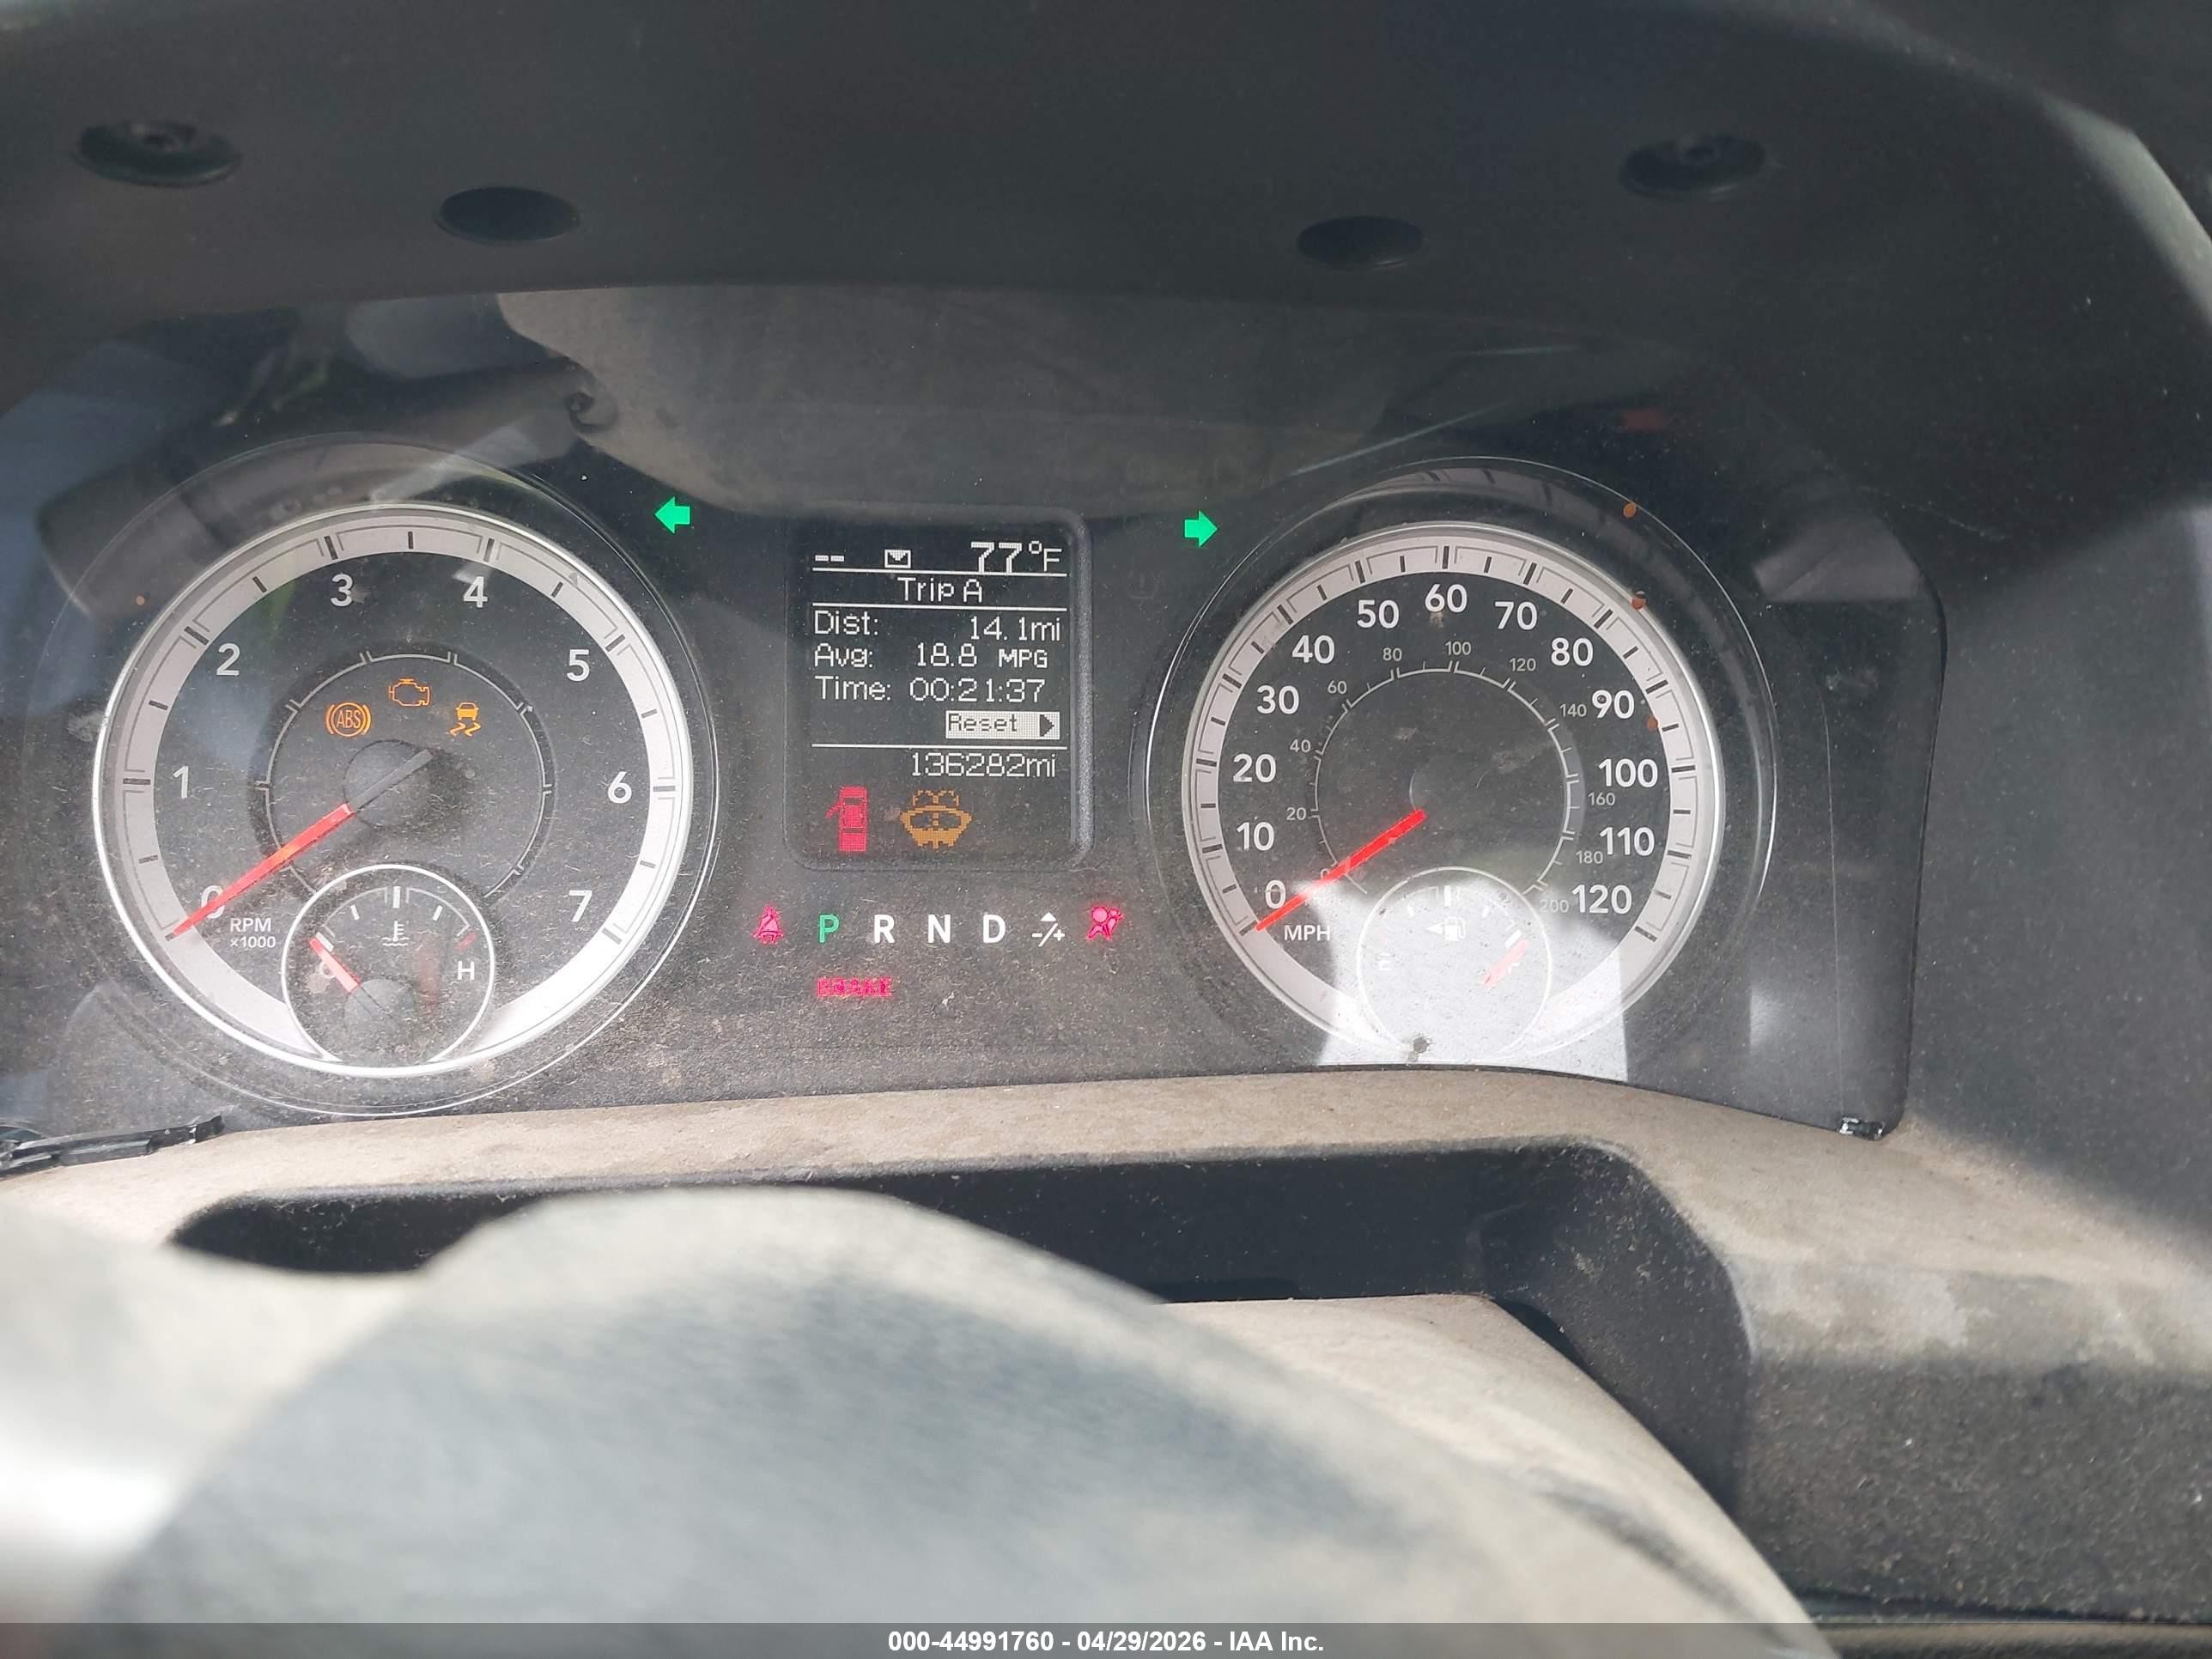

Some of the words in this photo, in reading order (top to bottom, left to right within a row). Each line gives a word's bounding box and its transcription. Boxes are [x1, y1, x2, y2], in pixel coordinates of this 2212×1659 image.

[330, 573, 354, 607] 3
[462, 575, 489, 608] 4
[896, 577, 956, 603] Trip
[963, 579, 983, 604] A
[1425, 583, 1468, 613] 60
[814, 610, 879, 635] Dist:
[1356, 599, 1400, 629] 50
[1494, 601, 1539, 630] 70
[216, 642, 241, 676] 2
[814, 642, 874, 668] Avg:
[916, 642, 978, 668] 18.8
[998, 648, 1048, 669] MPG
[1291, 635, 1335, 664] 40
[1382, 647, 1402, 662] 80
[1444, 641, 1472, 656] 100
[1550, 637, 1594, 666] 80
[565, 647, 591, 682] 5
[1509, 657, 1537, 672] 120
[814, 675, 892, 702] Time:
[908, 677, 1046, 702] 00:21:37
[1256, 685, 1299, 714] 30
[1327, 679, 1347, 695] 60
[337, 708, 361, 729] ABS
[1559, 703, 1587, 718] 140
[1591, 690, 1635, 719] 90
[948, 713, 1018, 733] Reset
[1289, 738, 1311, 754] 40
[911, 752, 1056, 778] 136282mi
[1232, 753, 1277, 783] 20
[1597, 758, 1659, 788] 100
[173, 765, 191, 799] 1
[607, 770, 633, 804] 6
[1588, 792, 1616, 806] 160
[1285, 806, 1307, 822] 20
[1236, 821, 1275, 852] 10
[1599, 826, 1656, 857] 110
[1575, 850, 1604, 865] 180
[568, 890, 593, 923] 7
[1264, 879, 1287, 909] 0
[1571, 884, 1632, 915] 120
[229, 917, 272, 933] RPM
[817, 913, 841, 944] P
[873, 913, 896, 944] R
[927, 913, 951, 944] N
[982, 914, 1006, 944] D
[1283, 924, 1331, 942] MPH
[457, 960, 476, 981] H
